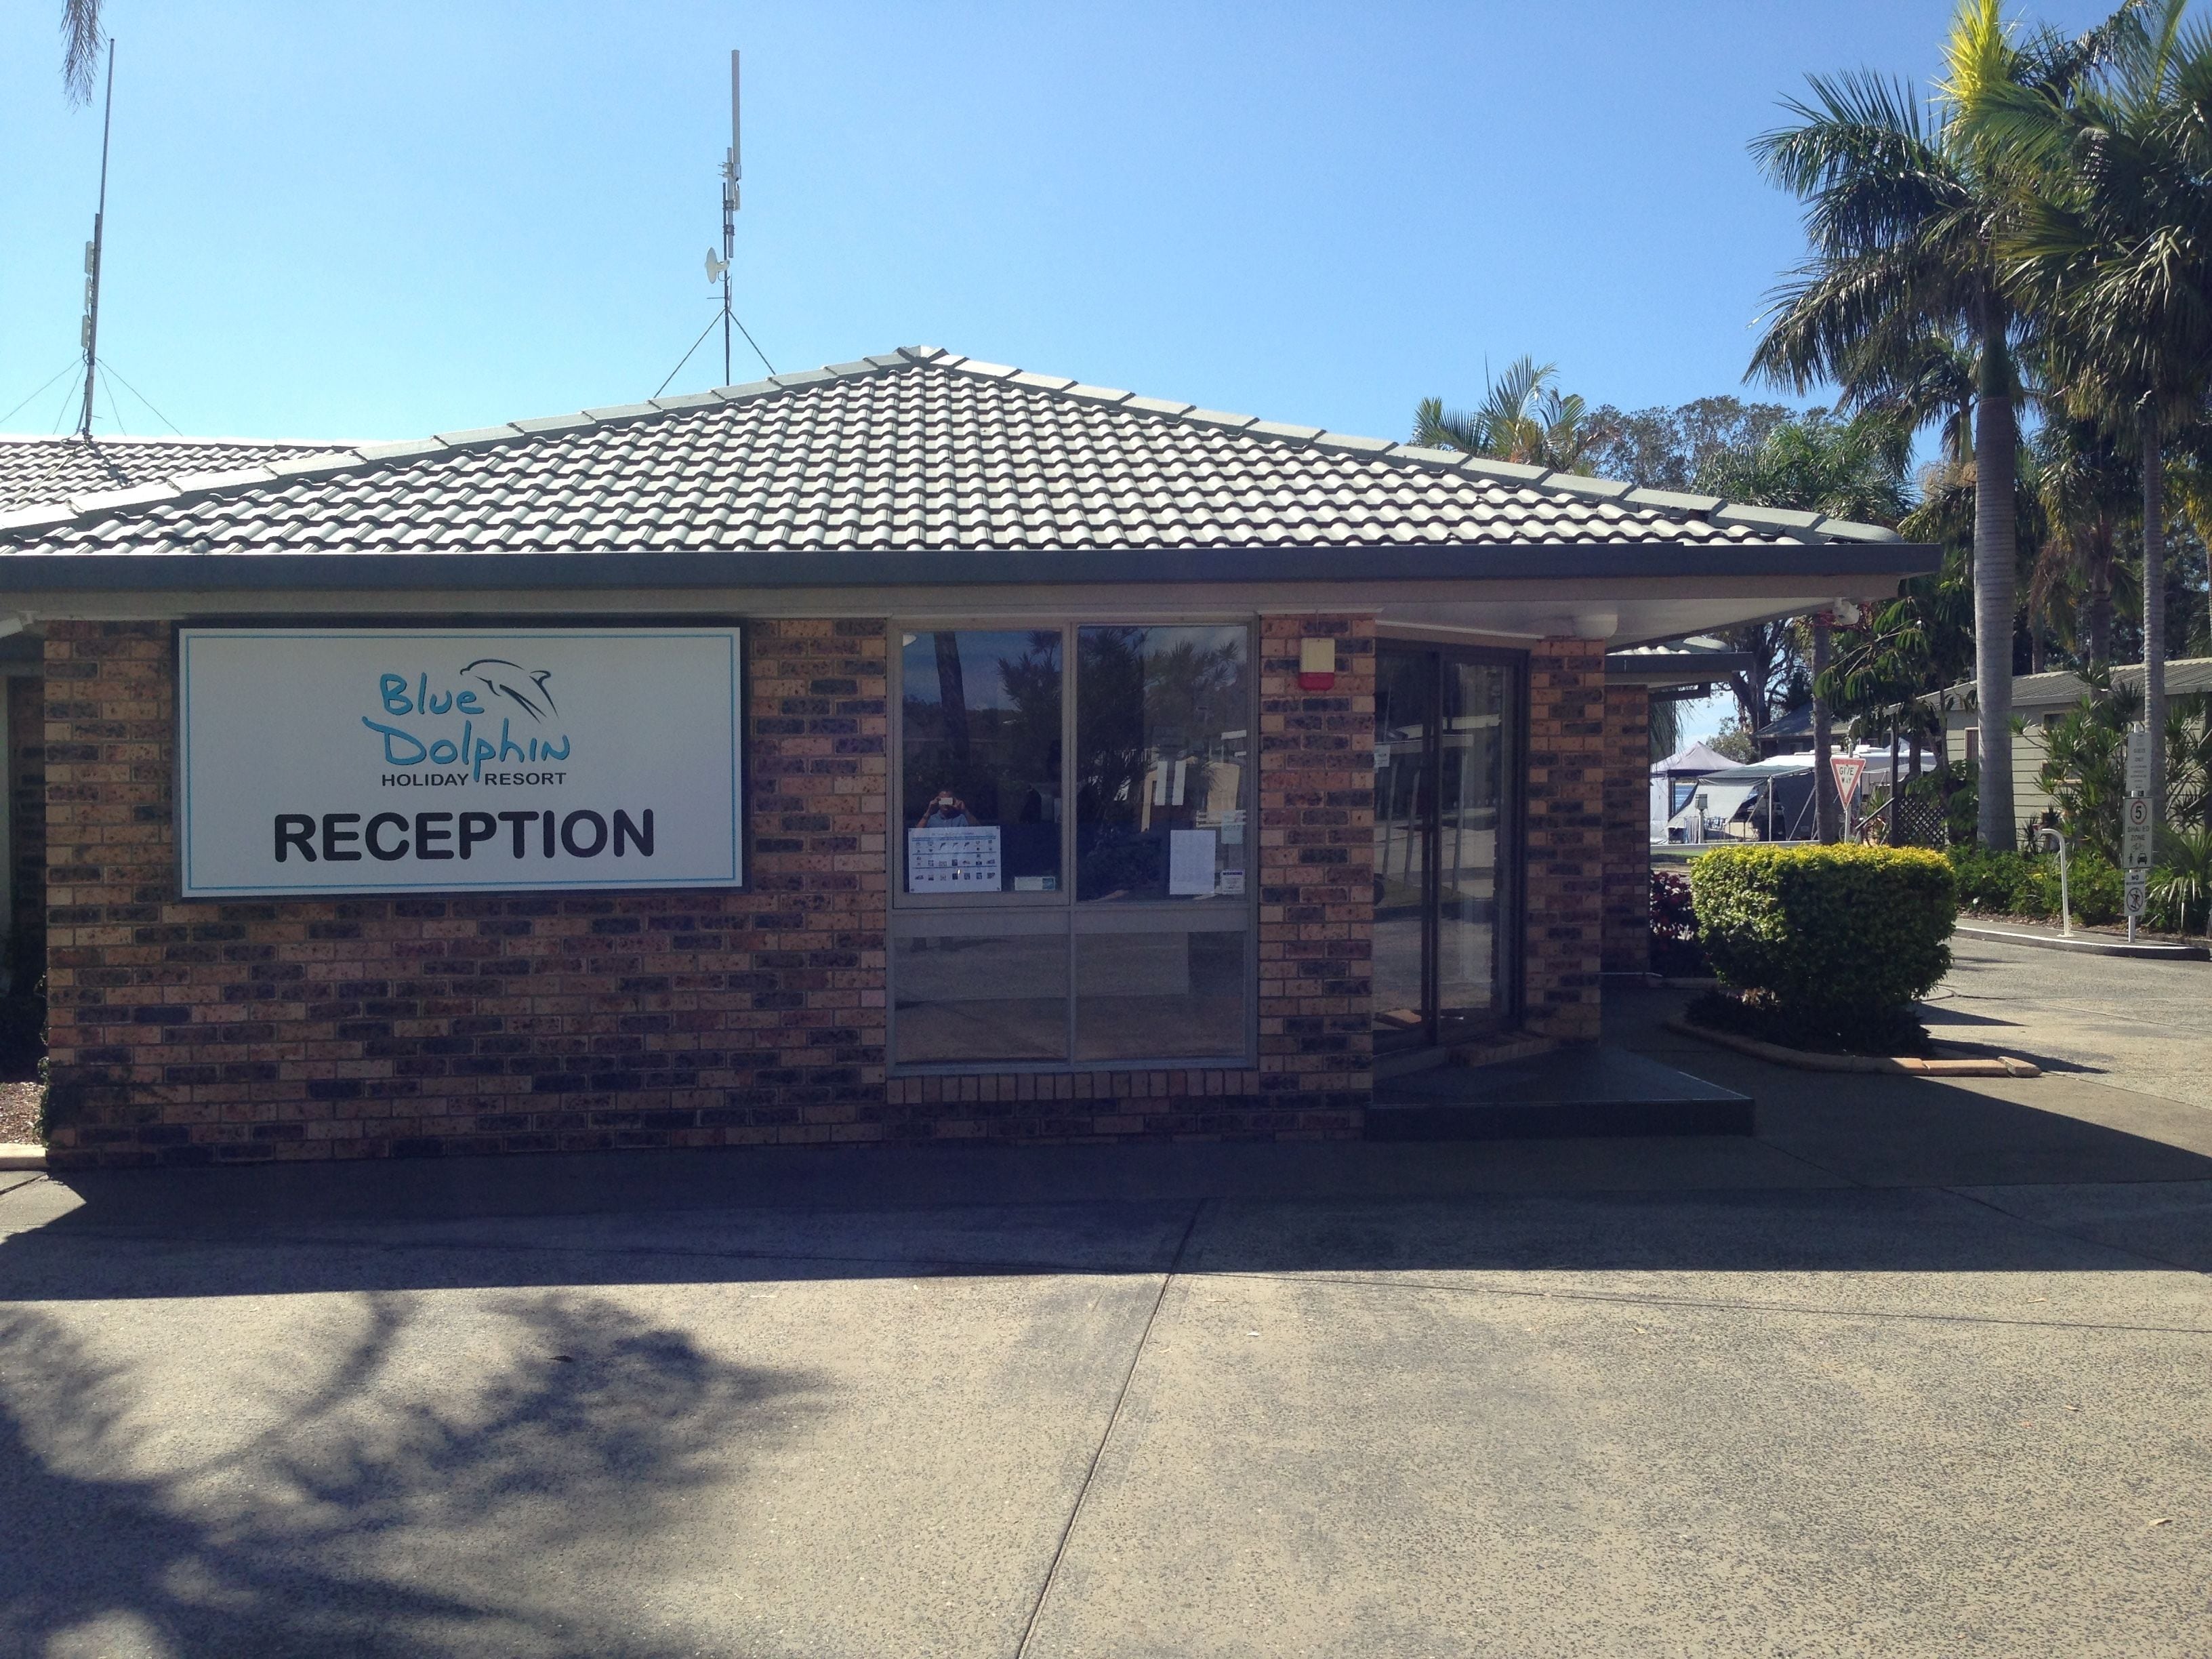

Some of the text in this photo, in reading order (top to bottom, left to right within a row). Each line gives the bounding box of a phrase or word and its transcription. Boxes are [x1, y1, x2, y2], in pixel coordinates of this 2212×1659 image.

[380, 673, 485, 716] Blue
[1839, 767, 1854, 775] GIVE
[381, 772, 567, 787] HOLIDAY RESORT
[2135, 805, 2142, 820] 5
[274, 808, 655, 863] RECEPTION
[2127, 825, 2150, 833] SHAED
